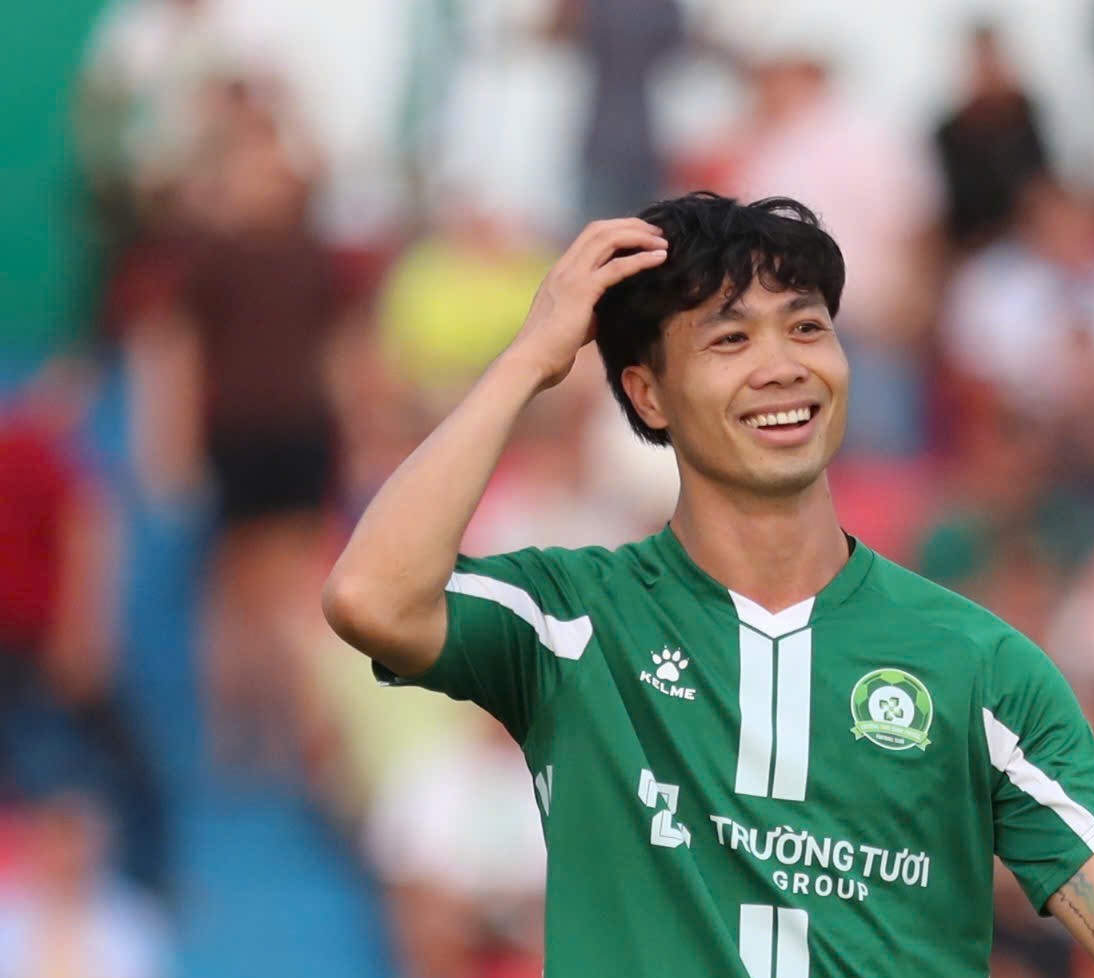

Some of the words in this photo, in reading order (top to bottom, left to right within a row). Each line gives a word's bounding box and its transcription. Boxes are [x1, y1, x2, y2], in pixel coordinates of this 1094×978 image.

[640, 670, 696, 700] KELME
[709, 814, 854, 873] TRƯỜNG
[859, 845, 930, 888] TƯƠI
[772, 870, 869, 901] GROUP
